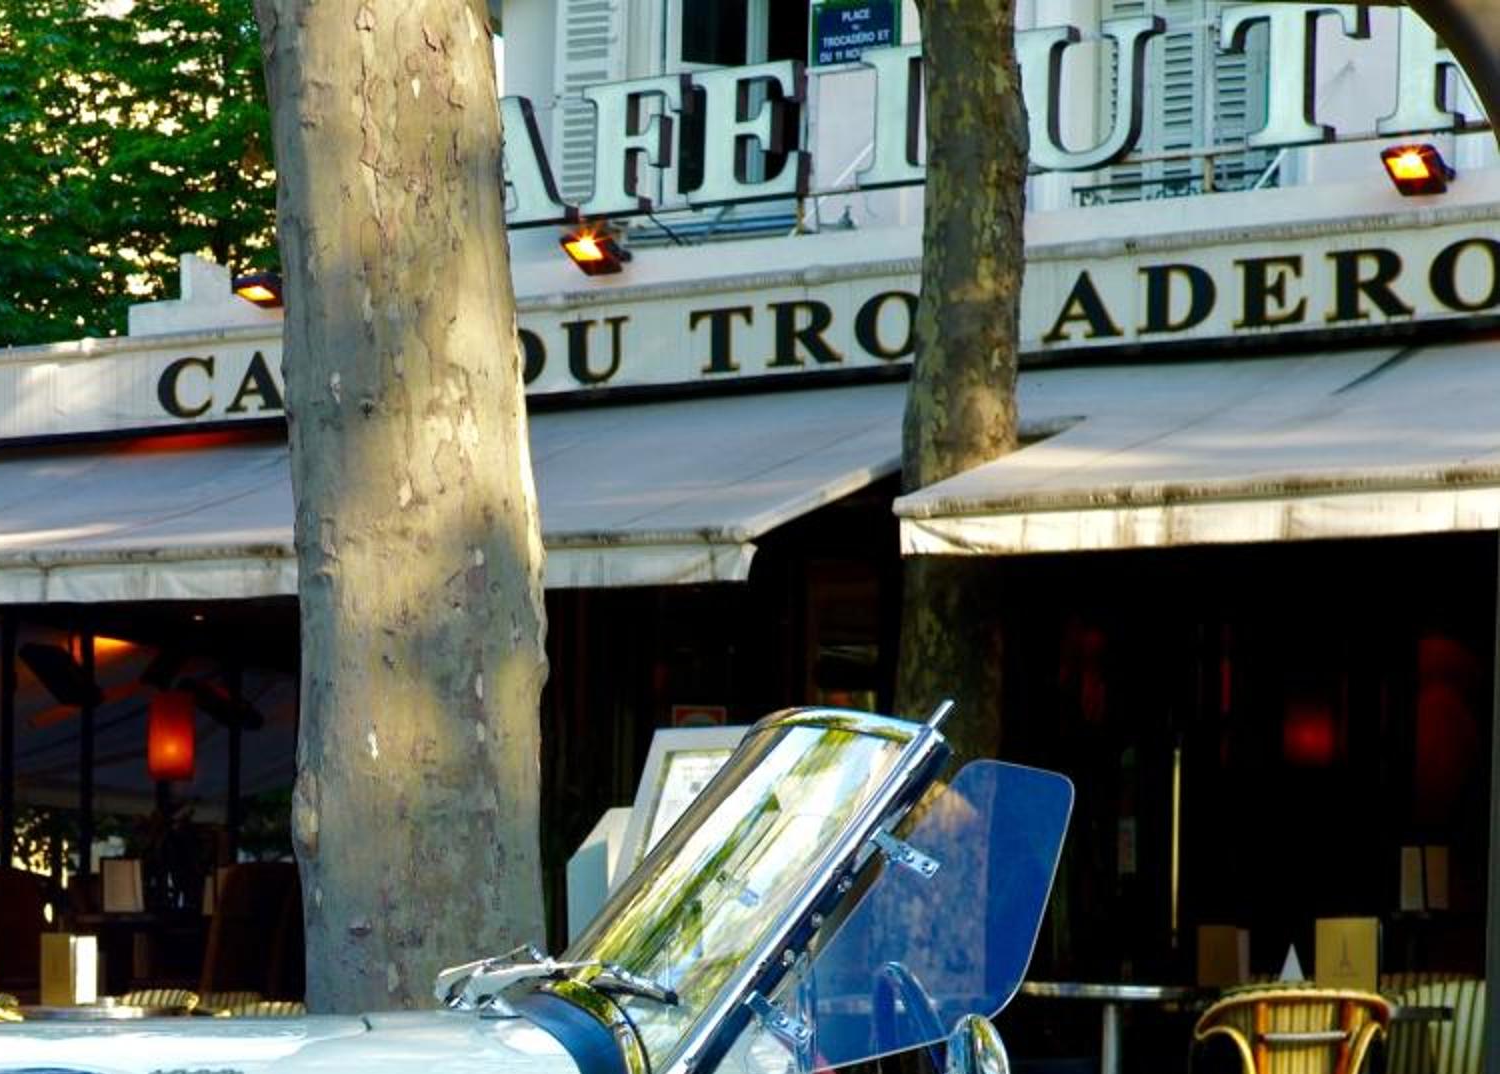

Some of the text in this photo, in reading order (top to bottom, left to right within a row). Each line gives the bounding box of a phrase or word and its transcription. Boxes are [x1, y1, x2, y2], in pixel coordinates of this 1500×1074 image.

[841, 8, 870, 22] PLACE
[877, 29, 891, 41] ET
[819, 51, 833, 63] DU
[689, 237, 1500, 375] TROADERO
